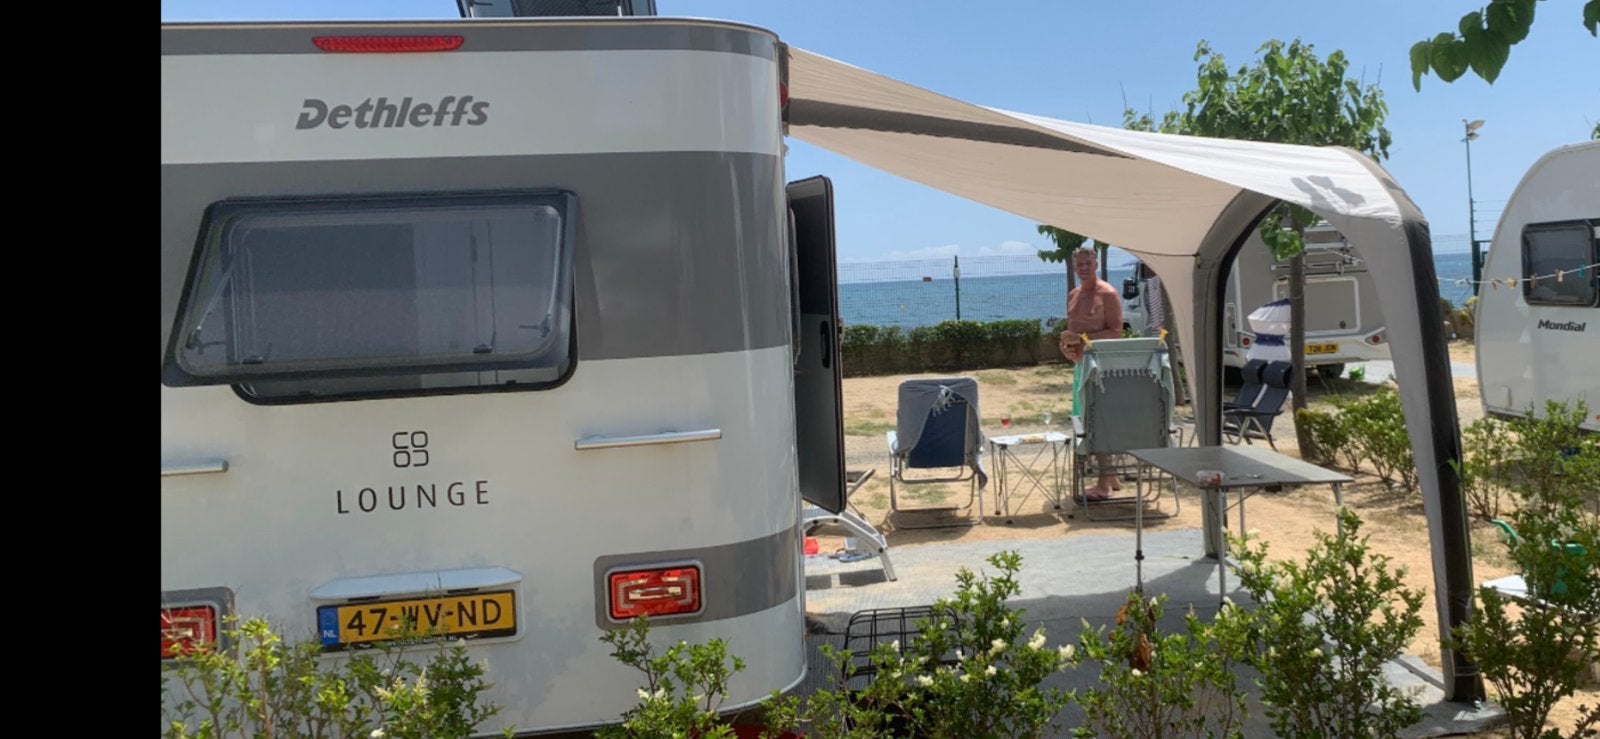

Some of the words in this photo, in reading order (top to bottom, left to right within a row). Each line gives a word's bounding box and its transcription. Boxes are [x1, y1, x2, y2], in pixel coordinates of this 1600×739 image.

[295, 95, 490, 130] Dethleffs
[1537, 319, 1587, 332] Mondial
[336, 480, 490, 515] LOUNGE
[323, 629, 336, 639] NL
[347, 598, 501, 636] 47-WV-ND
